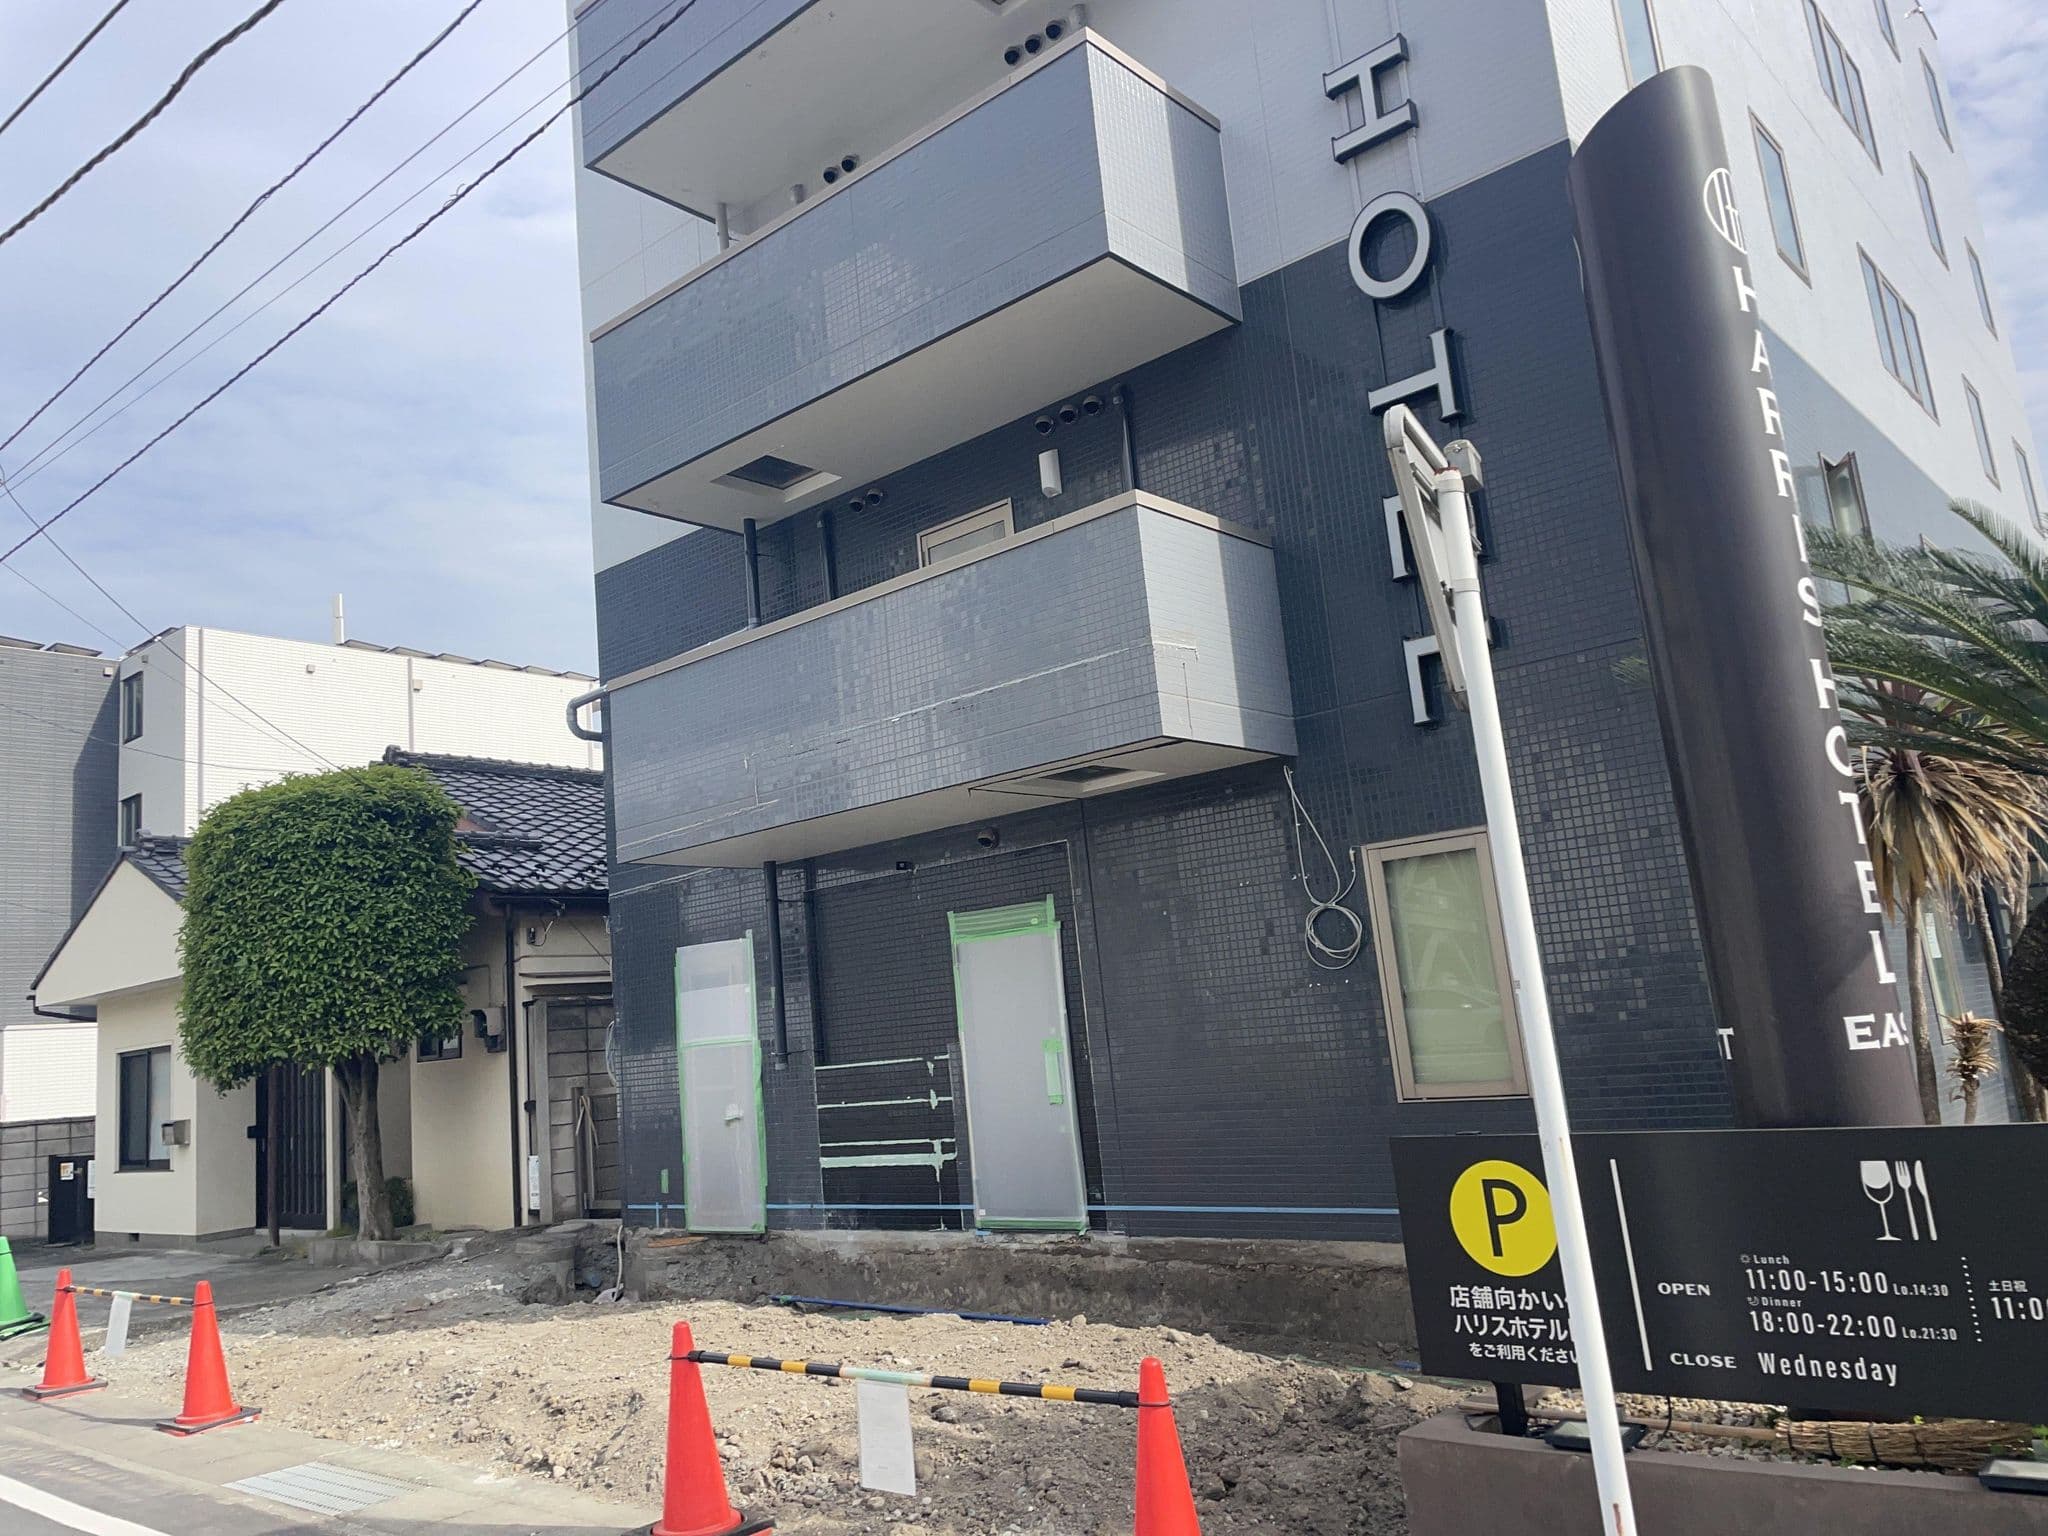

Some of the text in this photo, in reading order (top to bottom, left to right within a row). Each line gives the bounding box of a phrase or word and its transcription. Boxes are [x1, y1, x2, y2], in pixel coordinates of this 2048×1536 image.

[1481, 1178, 1527, 1258] P
[1753, 1254, 1790, 1265] Lunch
[1657, 1282, 1711, 1296] OPEN
[1745, 1268, 1888, 1294] 11:00-15:00
[1988, 1280, 2028, 1293] 土日祝
[1449, 1284, 1568, 1311] 店舗向かい
[1762, 1297, 1802, 1308] Dinner
[1990, 1297, 2048, 1321] 11:0
[1750, 1311, 1897, 1338] 18:00-22:00
[1669, 1352, 1897, 1387] CLOSE Wednesday
